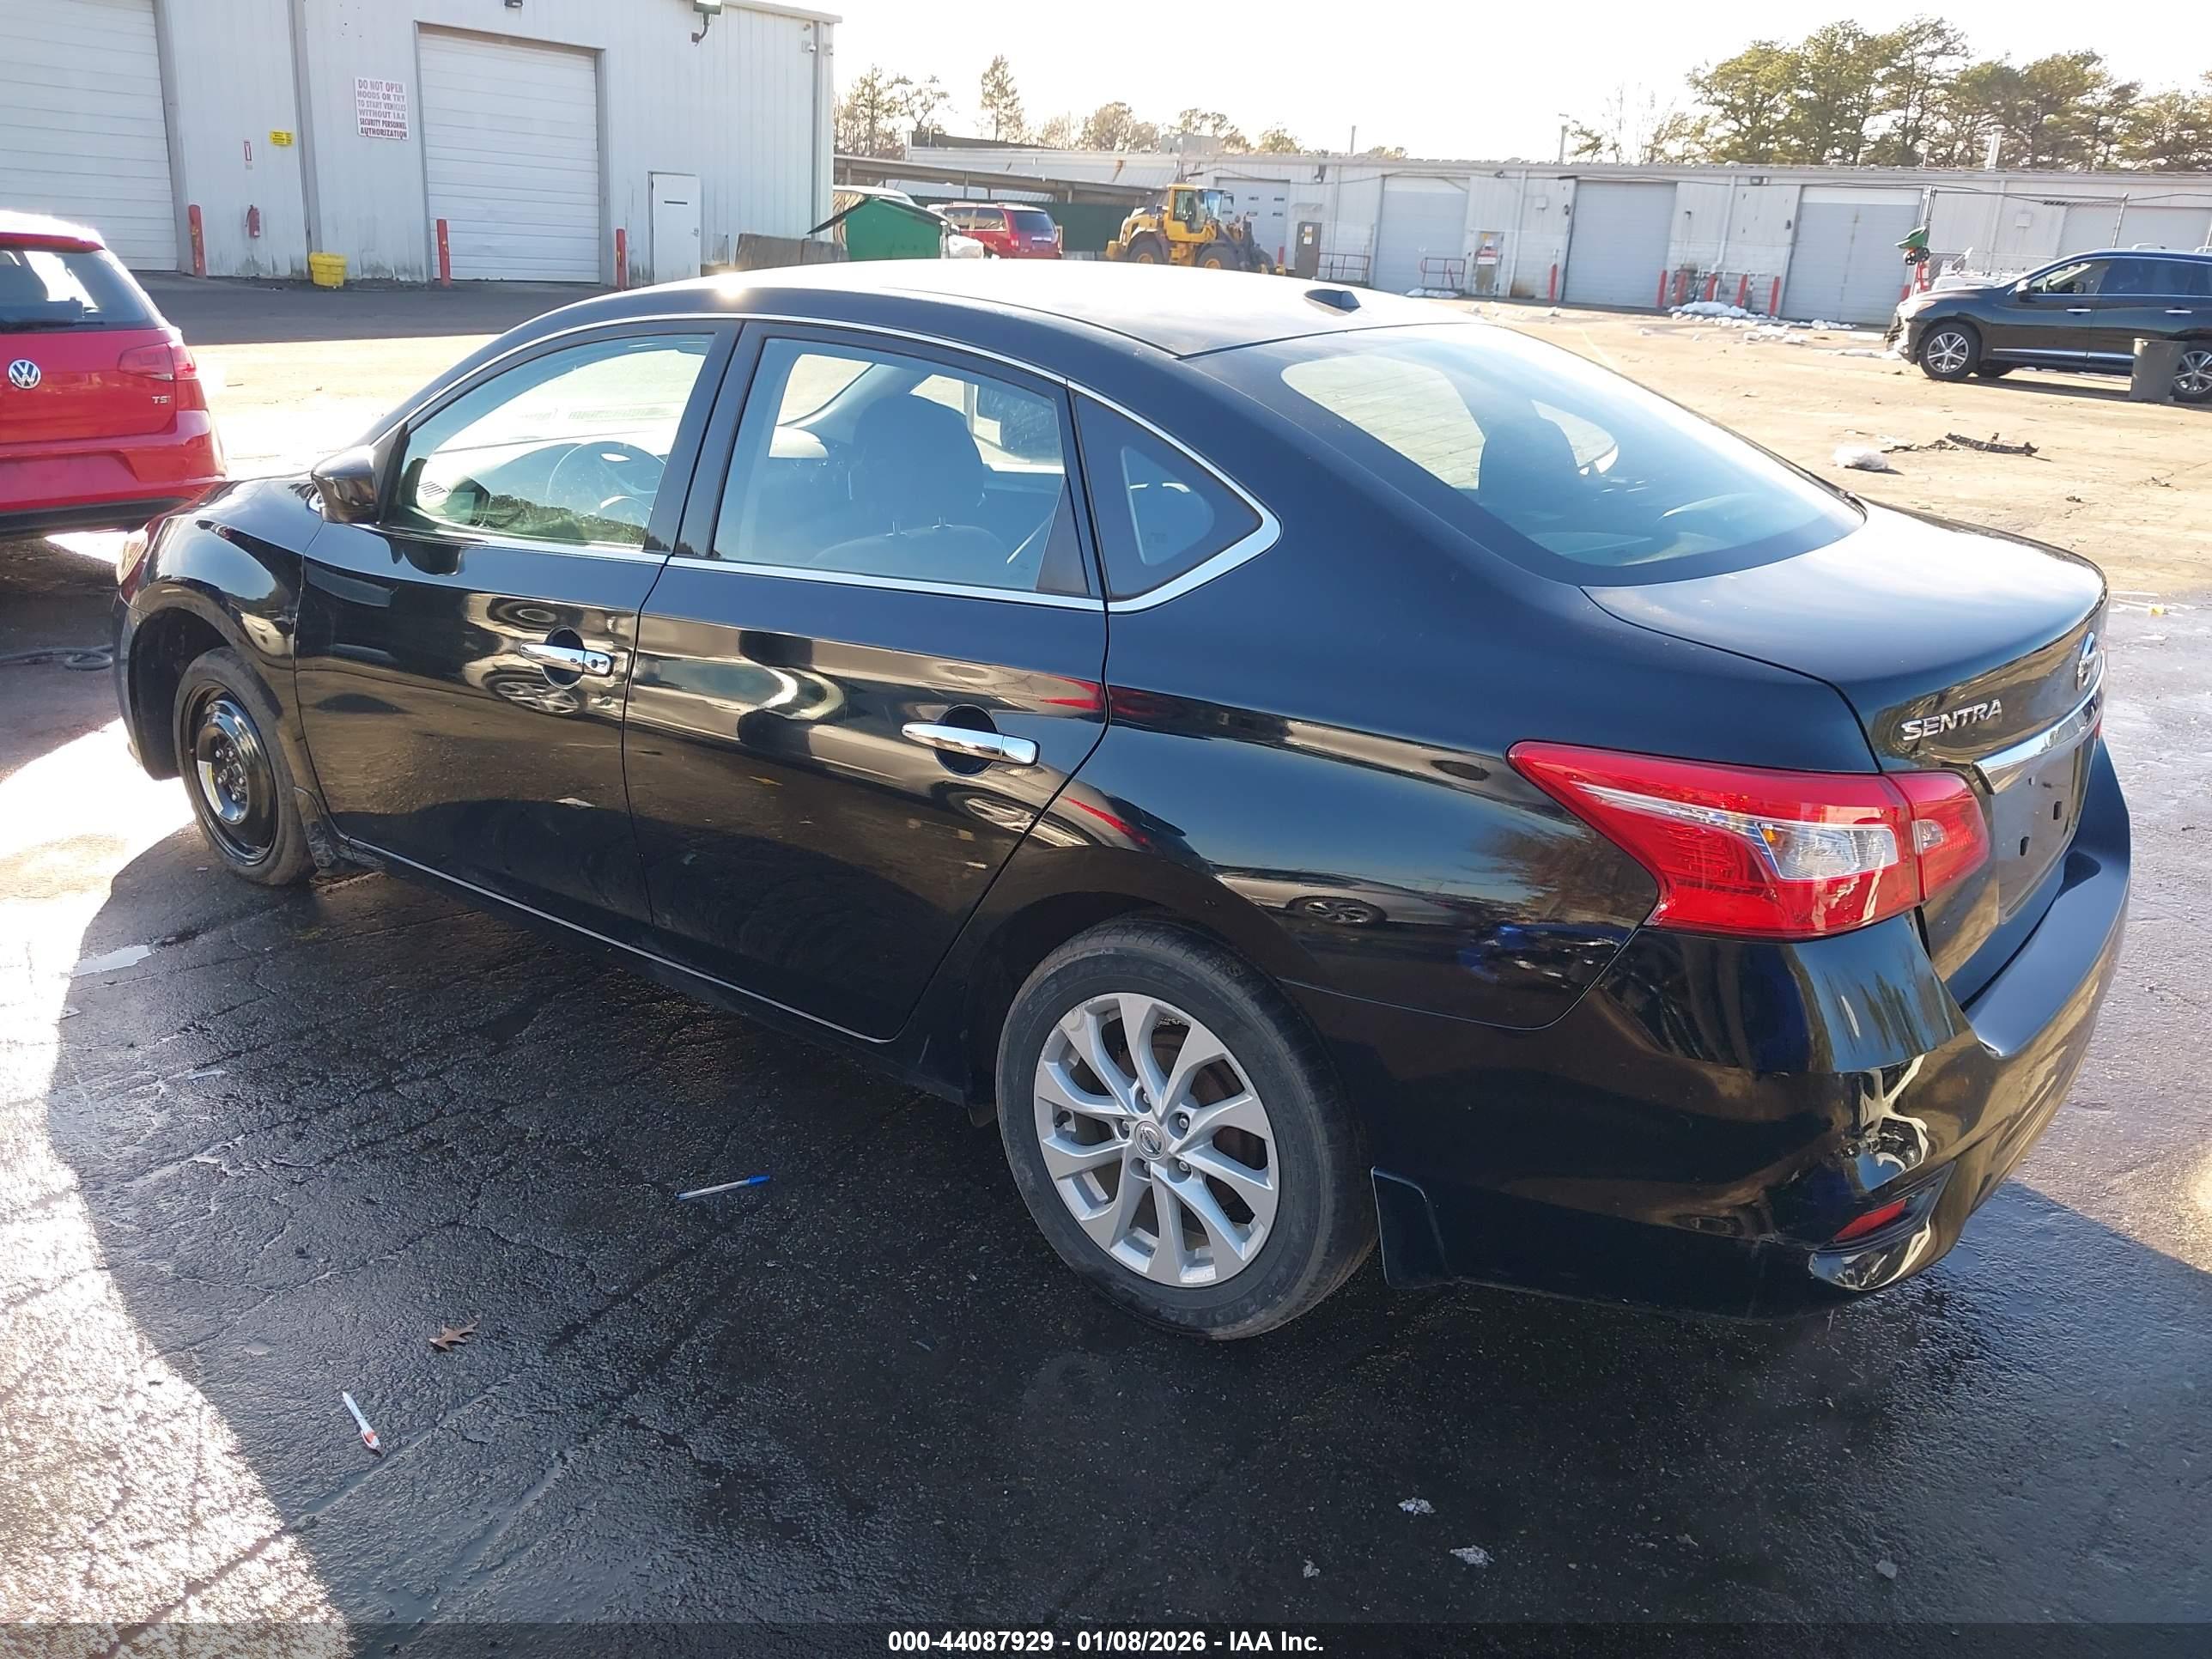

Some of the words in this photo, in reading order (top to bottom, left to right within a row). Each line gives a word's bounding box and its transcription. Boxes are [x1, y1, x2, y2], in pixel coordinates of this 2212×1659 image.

[358, 79, 368, 89] DO
[369, 81, 383, 91] NOT
[385, 82, 404, 94] OPEN
[357, 90, 380, 100] HOODS
[381, 93, 392, 101] OR
[366, 100, 382, 109] START
[383, 102, 406, 112] VEHICLES
[358, 108, 391, 118] WITHOUT
[392, 112, 405, 120] IAA
[359, 118, 380, 127] SECURITY
[381, 119, 407, 130] PERSONNEL
[360, 126, 407, 138] AUTHORIZATION
[1900, 698, 2002, 741] SENTRA
